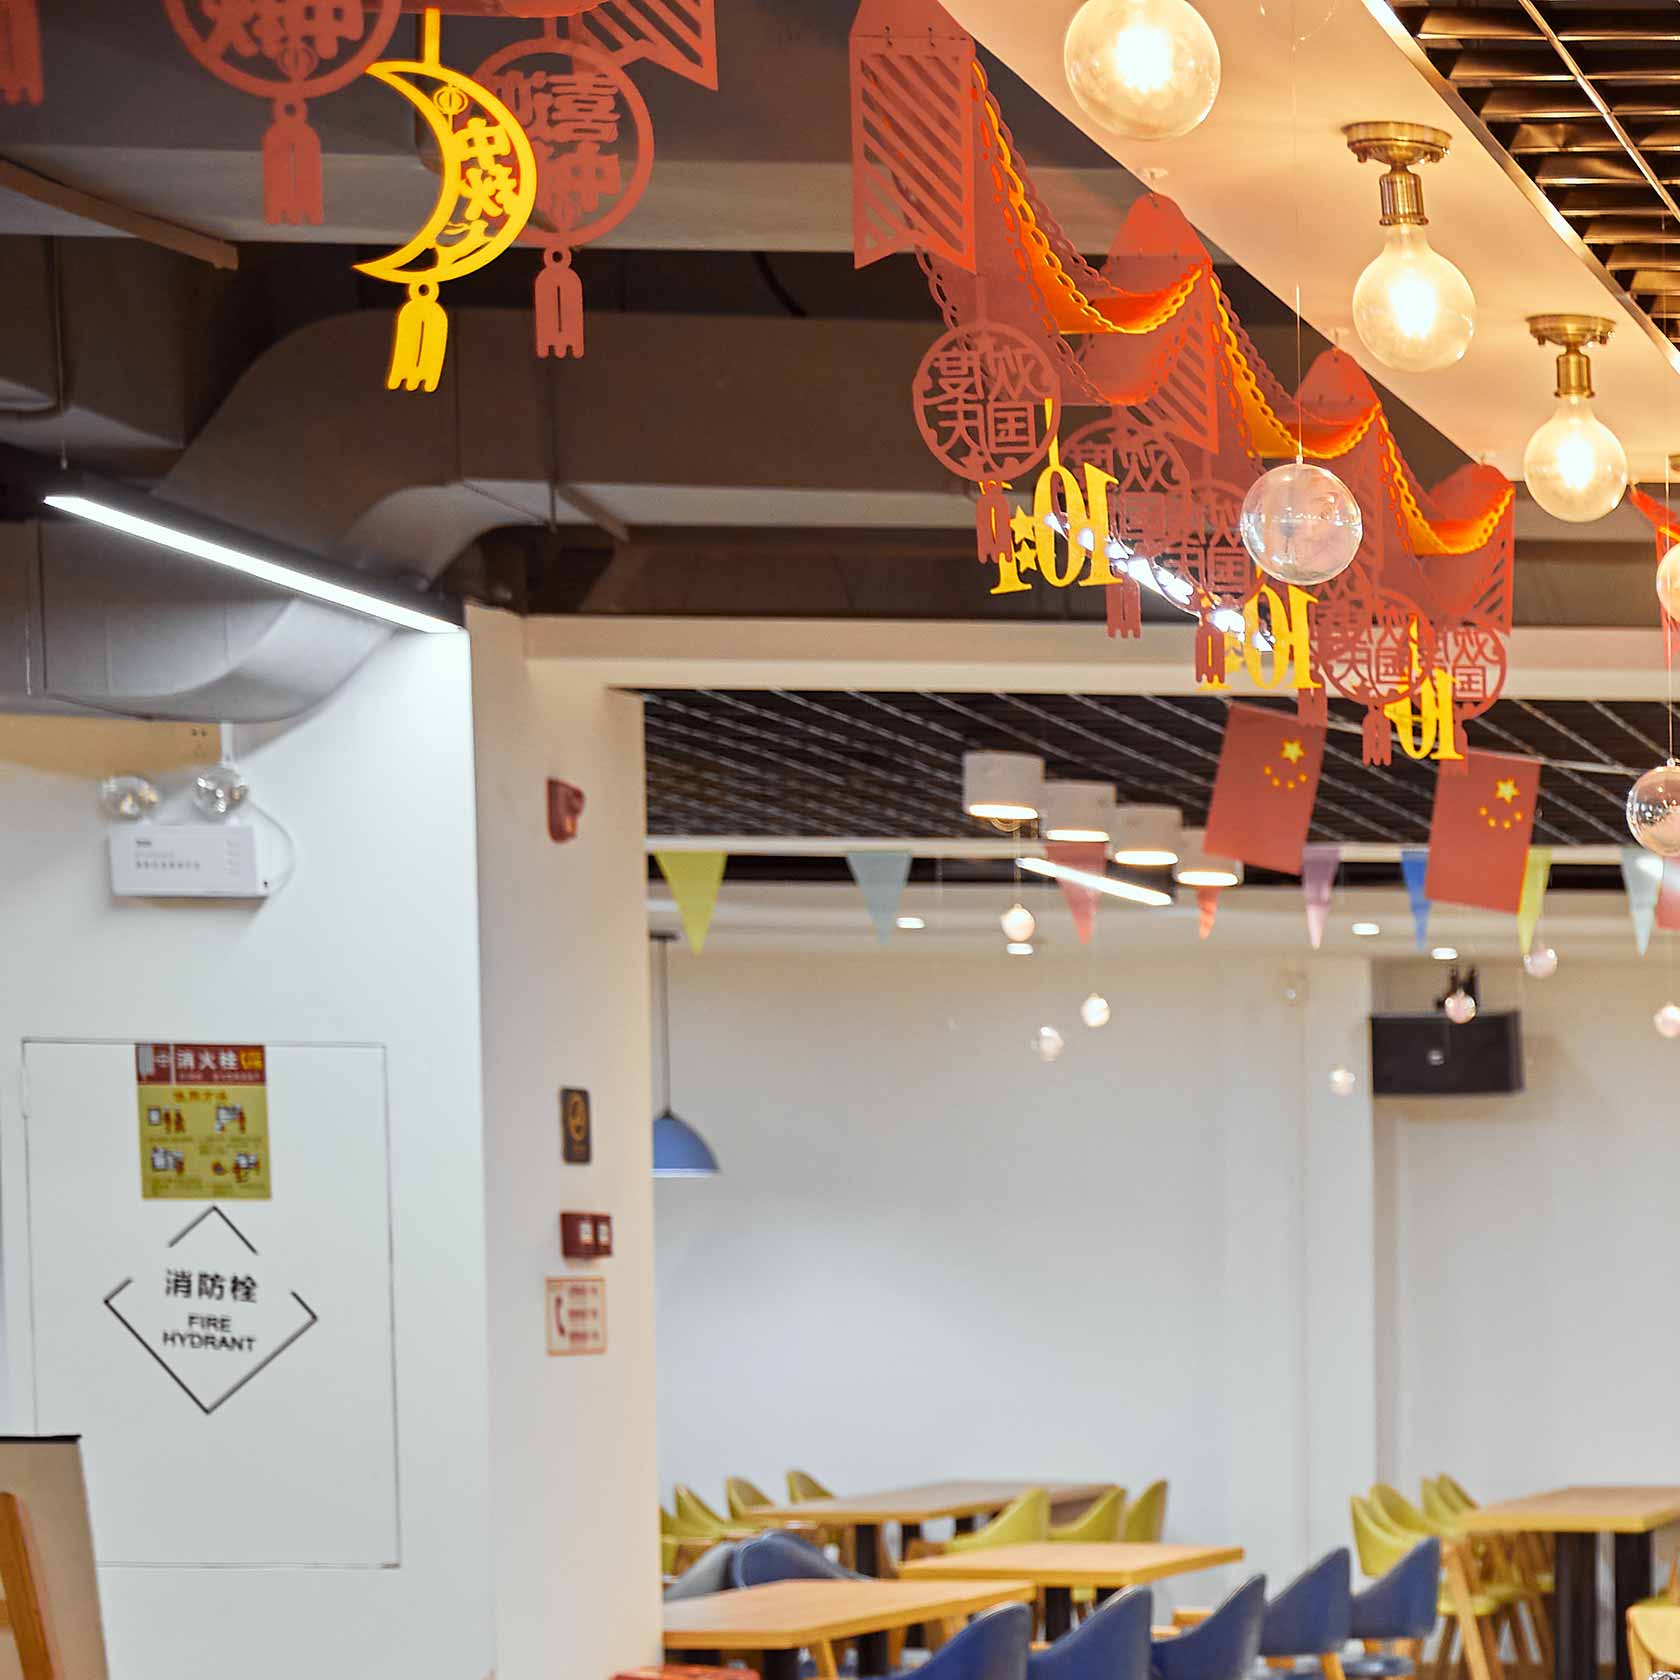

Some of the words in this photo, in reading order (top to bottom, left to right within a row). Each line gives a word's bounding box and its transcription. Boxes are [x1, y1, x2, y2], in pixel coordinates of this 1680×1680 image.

[165, 1268, 258, 1303] 消防栓
[188, 1313, 232, 1332] FIRE
[162, 1330, 256, 1352] HYDRANT
